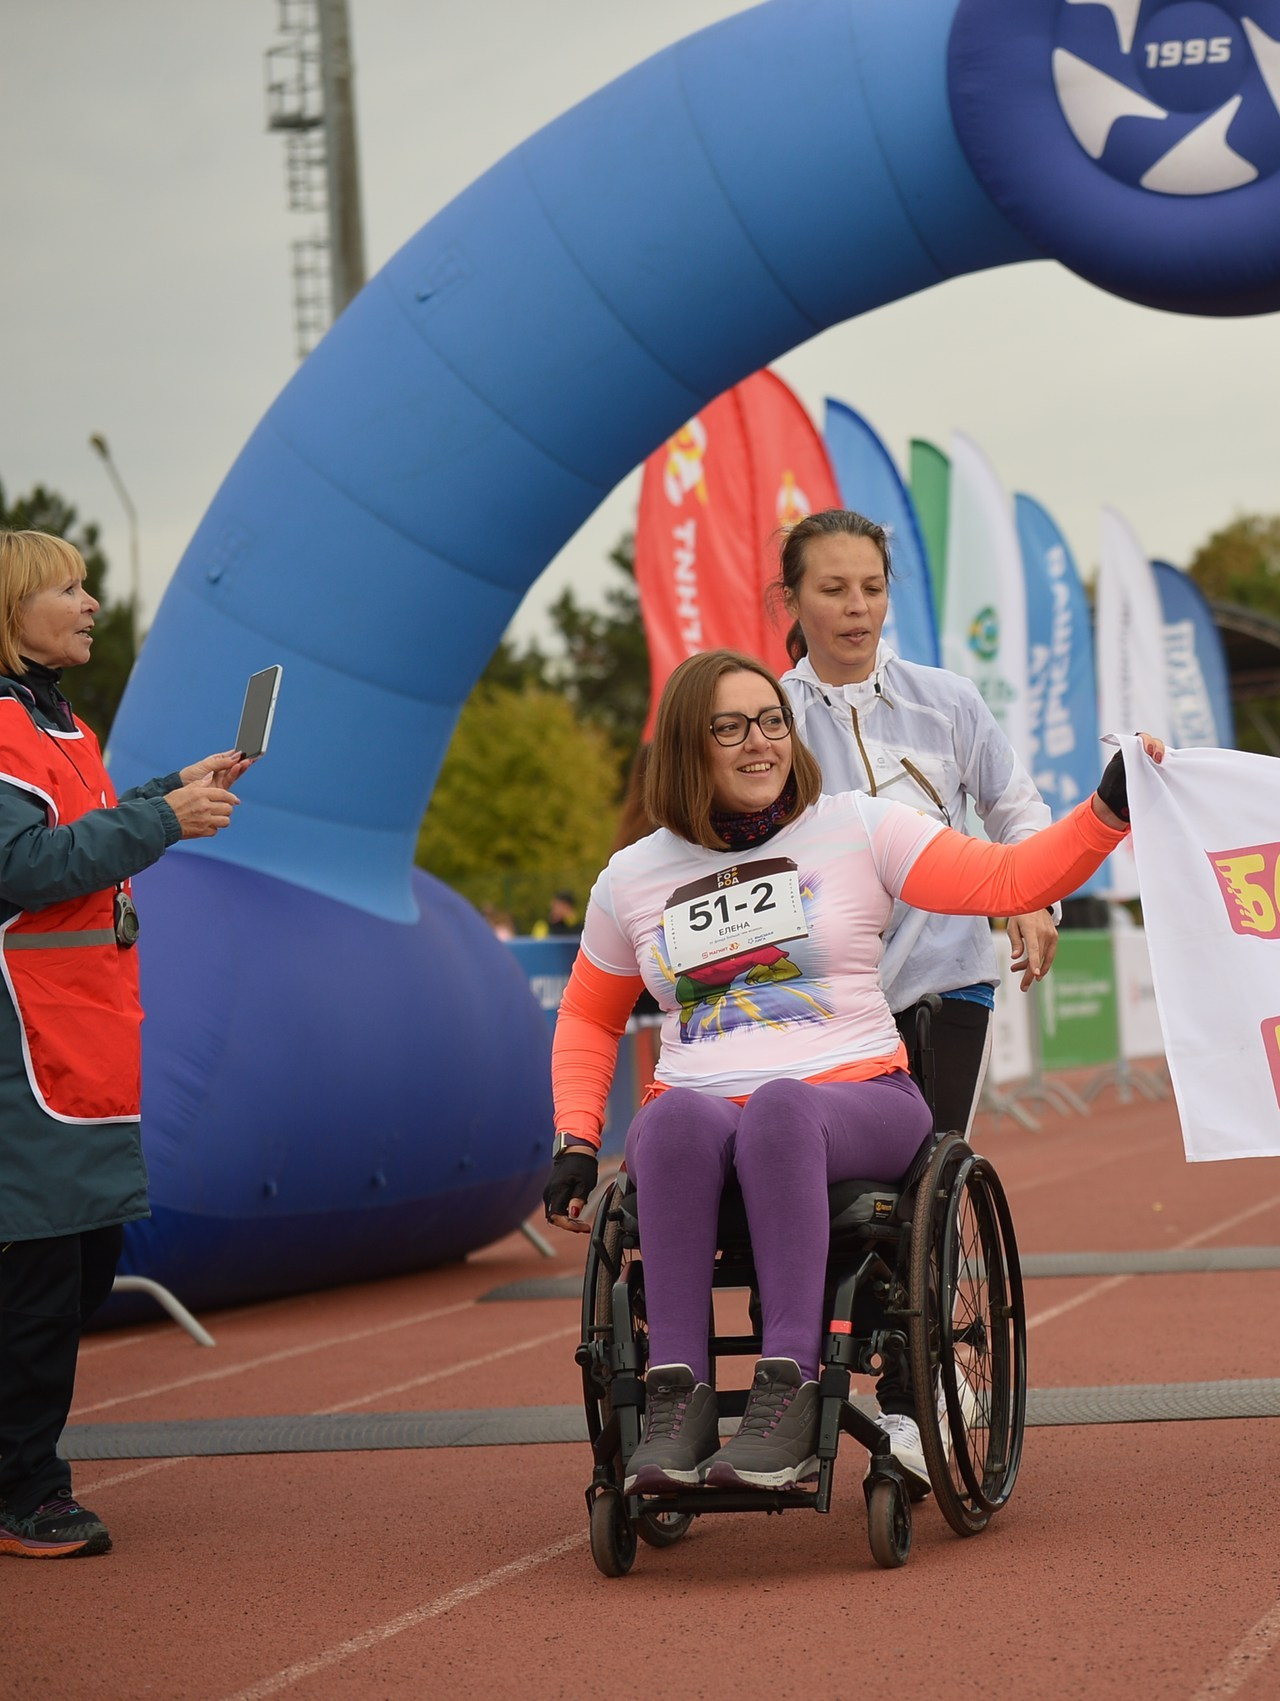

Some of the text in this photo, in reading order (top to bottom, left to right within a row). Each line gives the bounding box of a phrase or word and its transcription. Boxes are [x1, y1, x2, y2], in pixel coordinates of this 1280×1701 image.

[1144, 36, 1232, 69] 1995
[717, 878, 740, 889] РОД
[689, 882, 776, 932] 51-2
[718, 921, 751, 936] ЕЛЕНА
[708, 946, 729, 957] МАГНИТ
